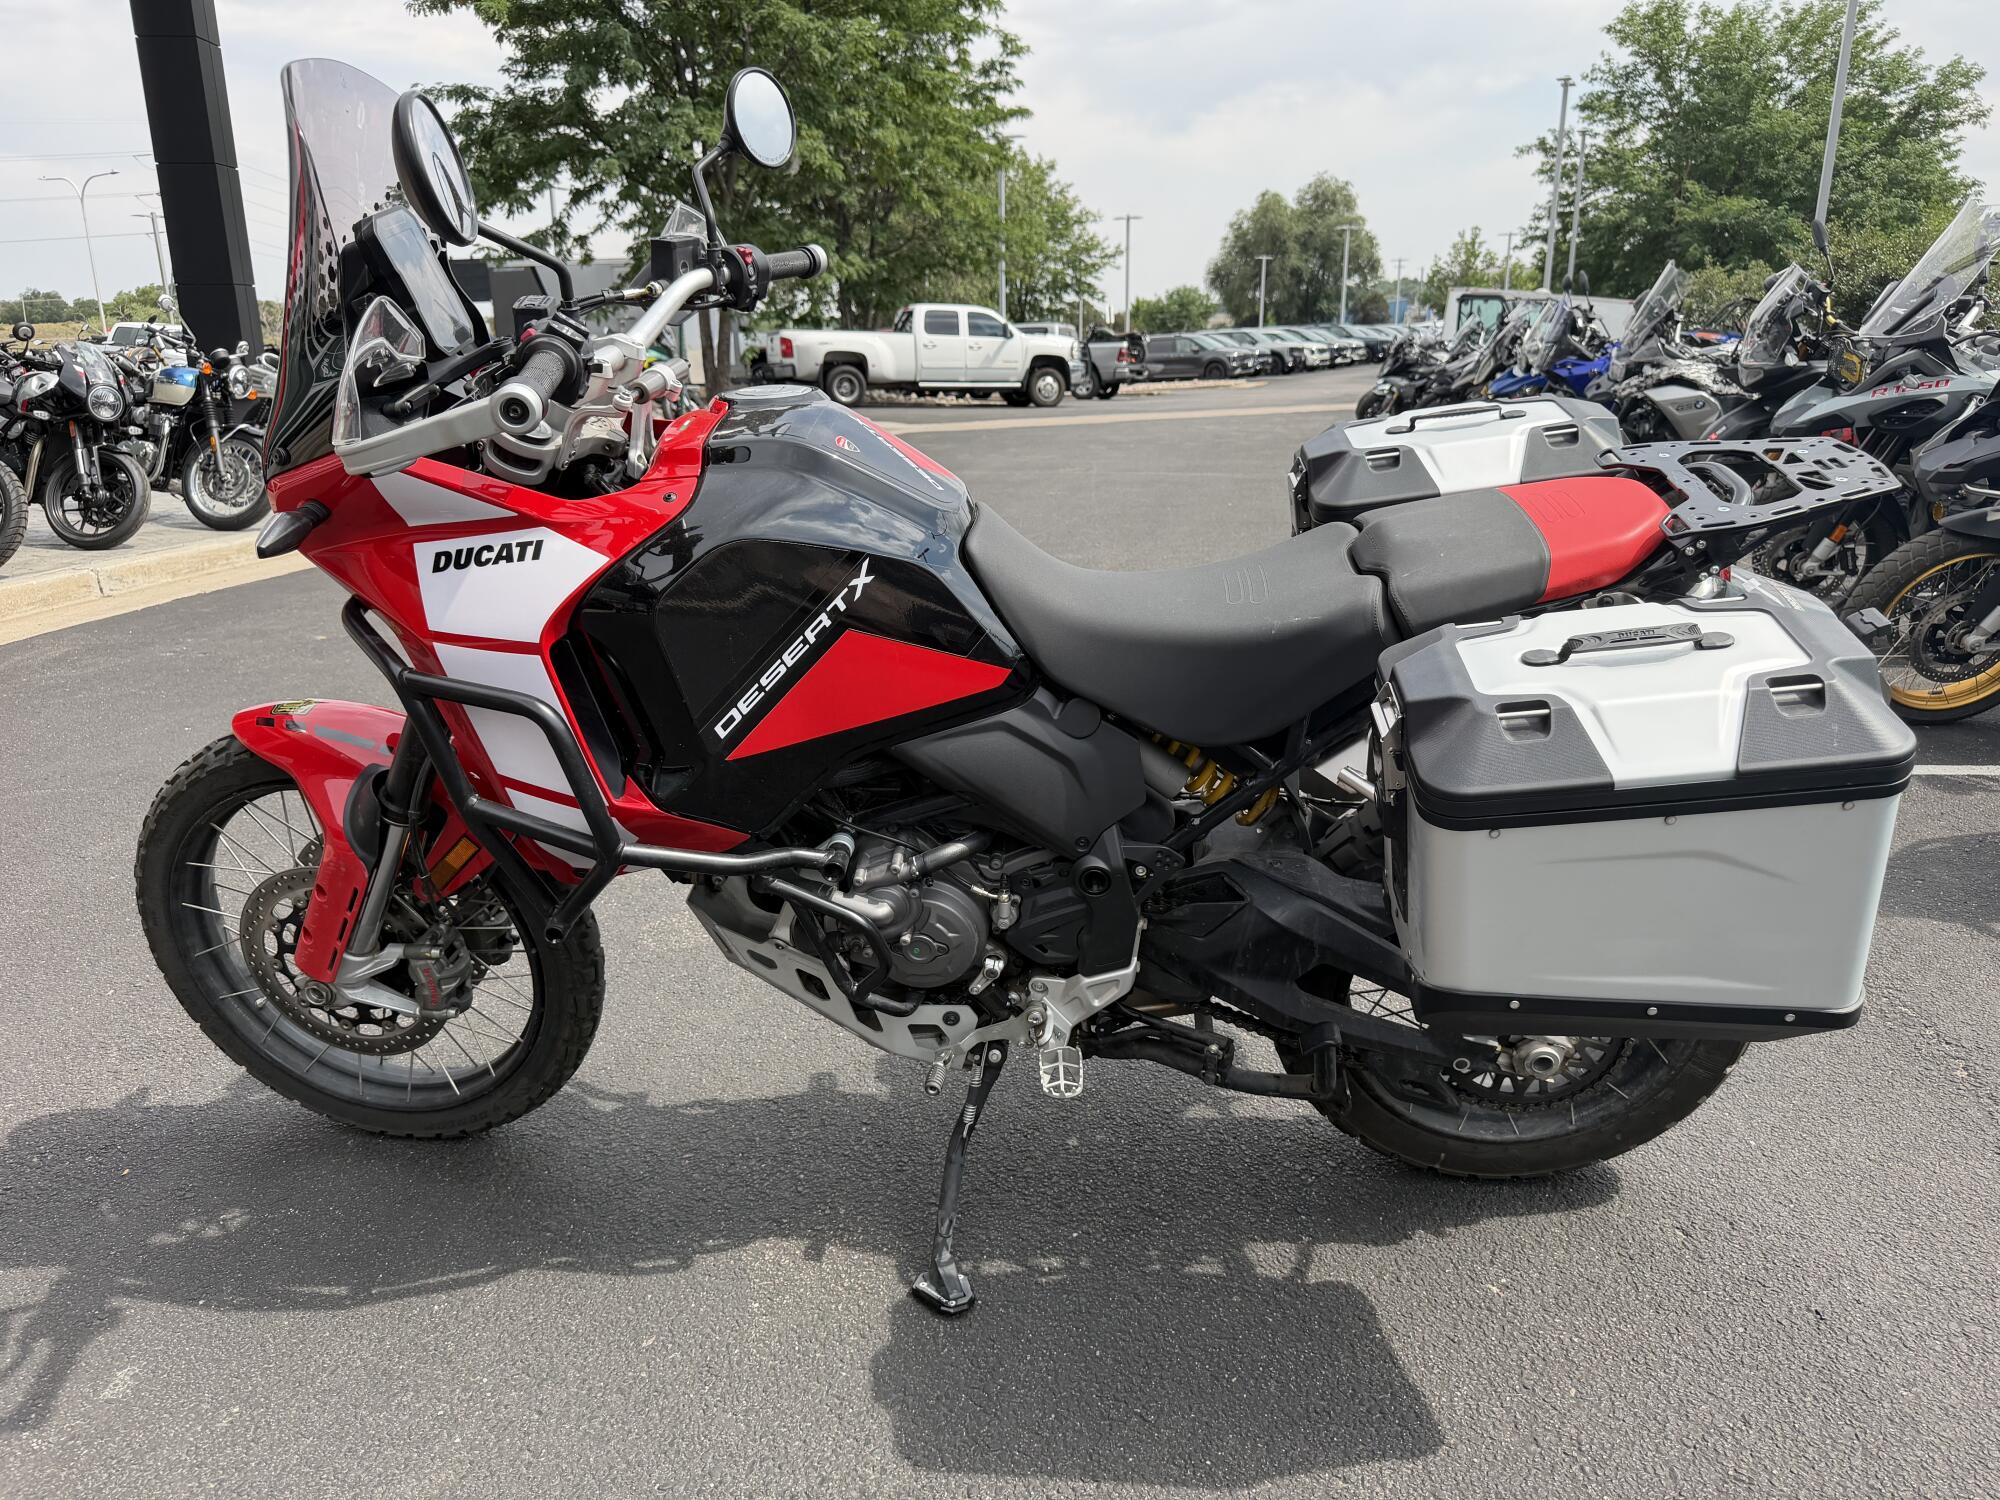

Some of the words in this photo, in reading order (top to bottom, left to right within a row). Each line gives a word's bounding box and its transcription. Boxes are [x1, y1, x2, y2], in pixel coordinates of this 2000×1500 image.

[1871, 387, 1888, 398] R
[432, 539, 544, 573] DUCATI
[1617, 629, 1656, 639] DUCATI
[714, 556, 875, 739] DESERTX
